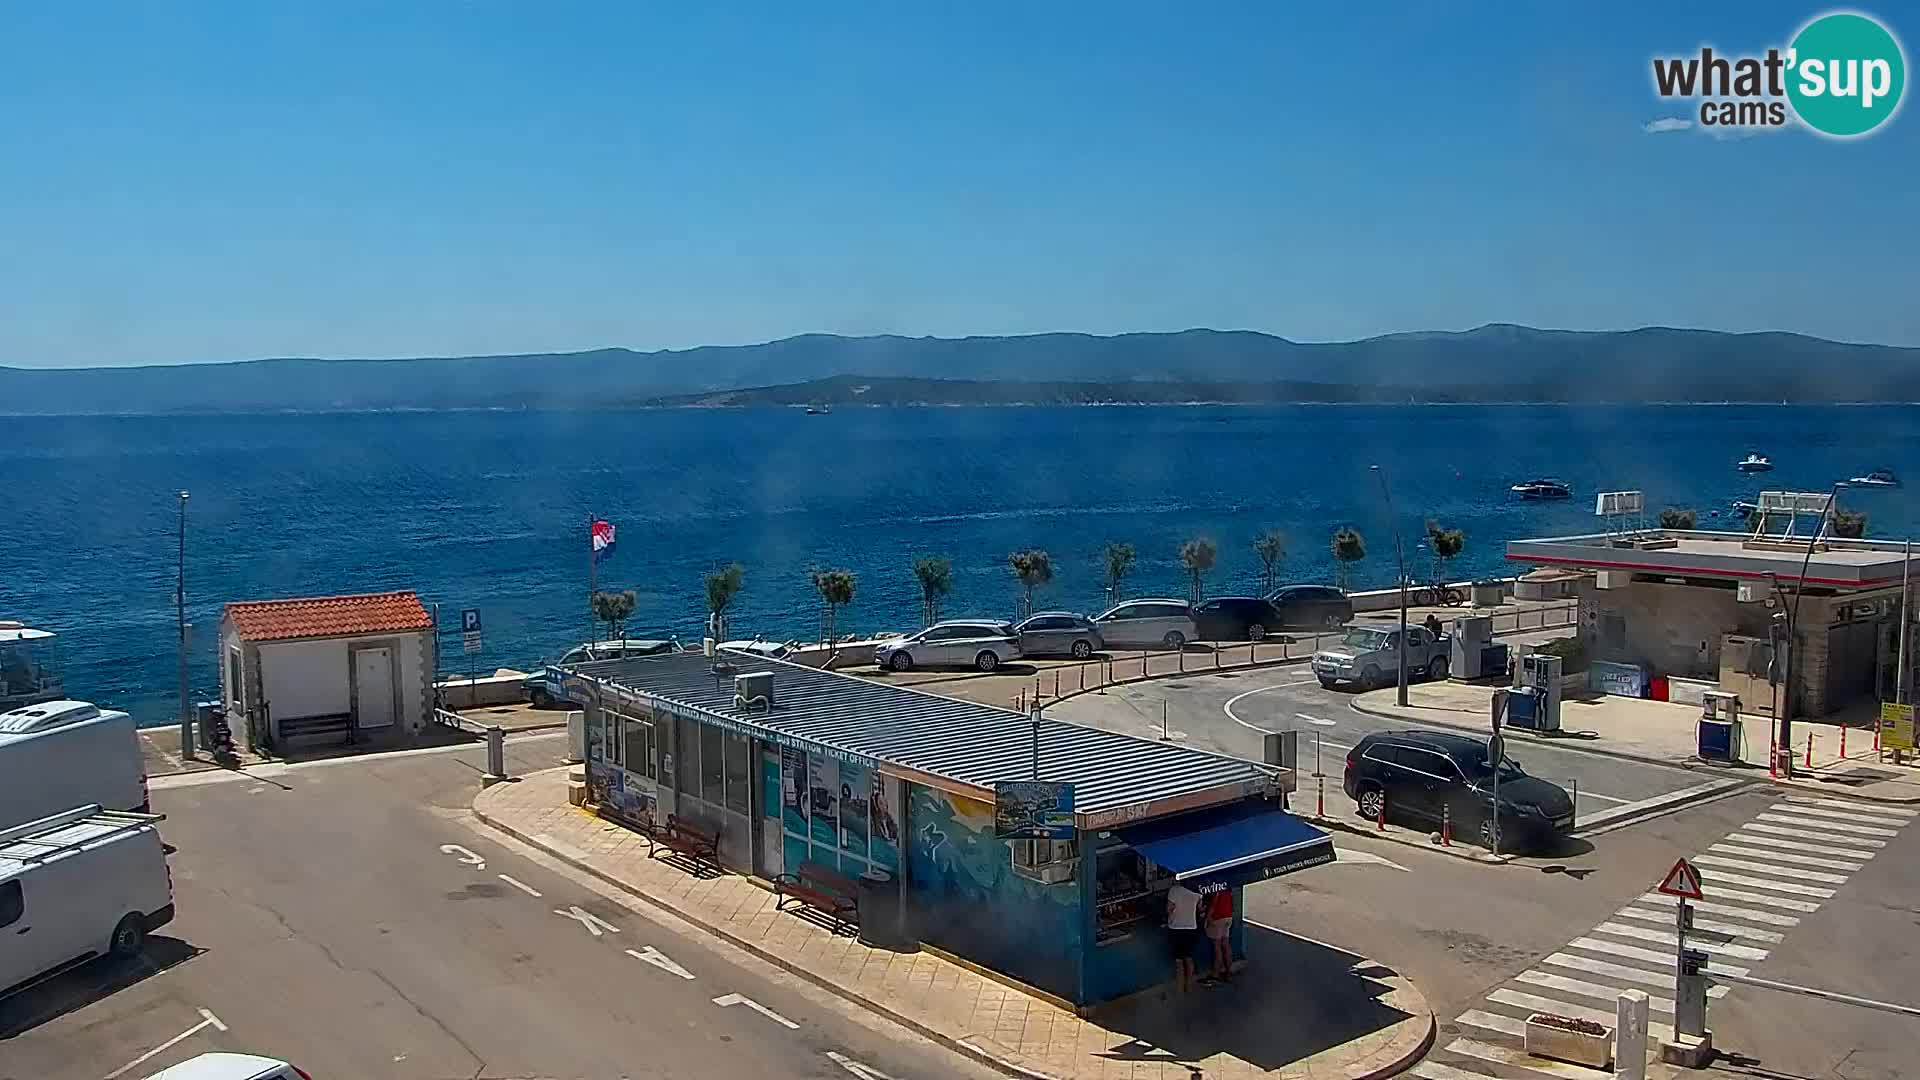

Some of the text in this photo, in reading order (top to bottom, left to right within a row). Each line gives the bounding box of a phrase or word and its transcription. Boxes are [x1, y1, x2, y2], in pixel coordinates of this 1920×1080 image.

[466, 611, 477, 629] P
[791, 739, 822, 754] STATION
[824, 746, 848, 761] TICKET
[849, 754, 875, 769] OFFICE
